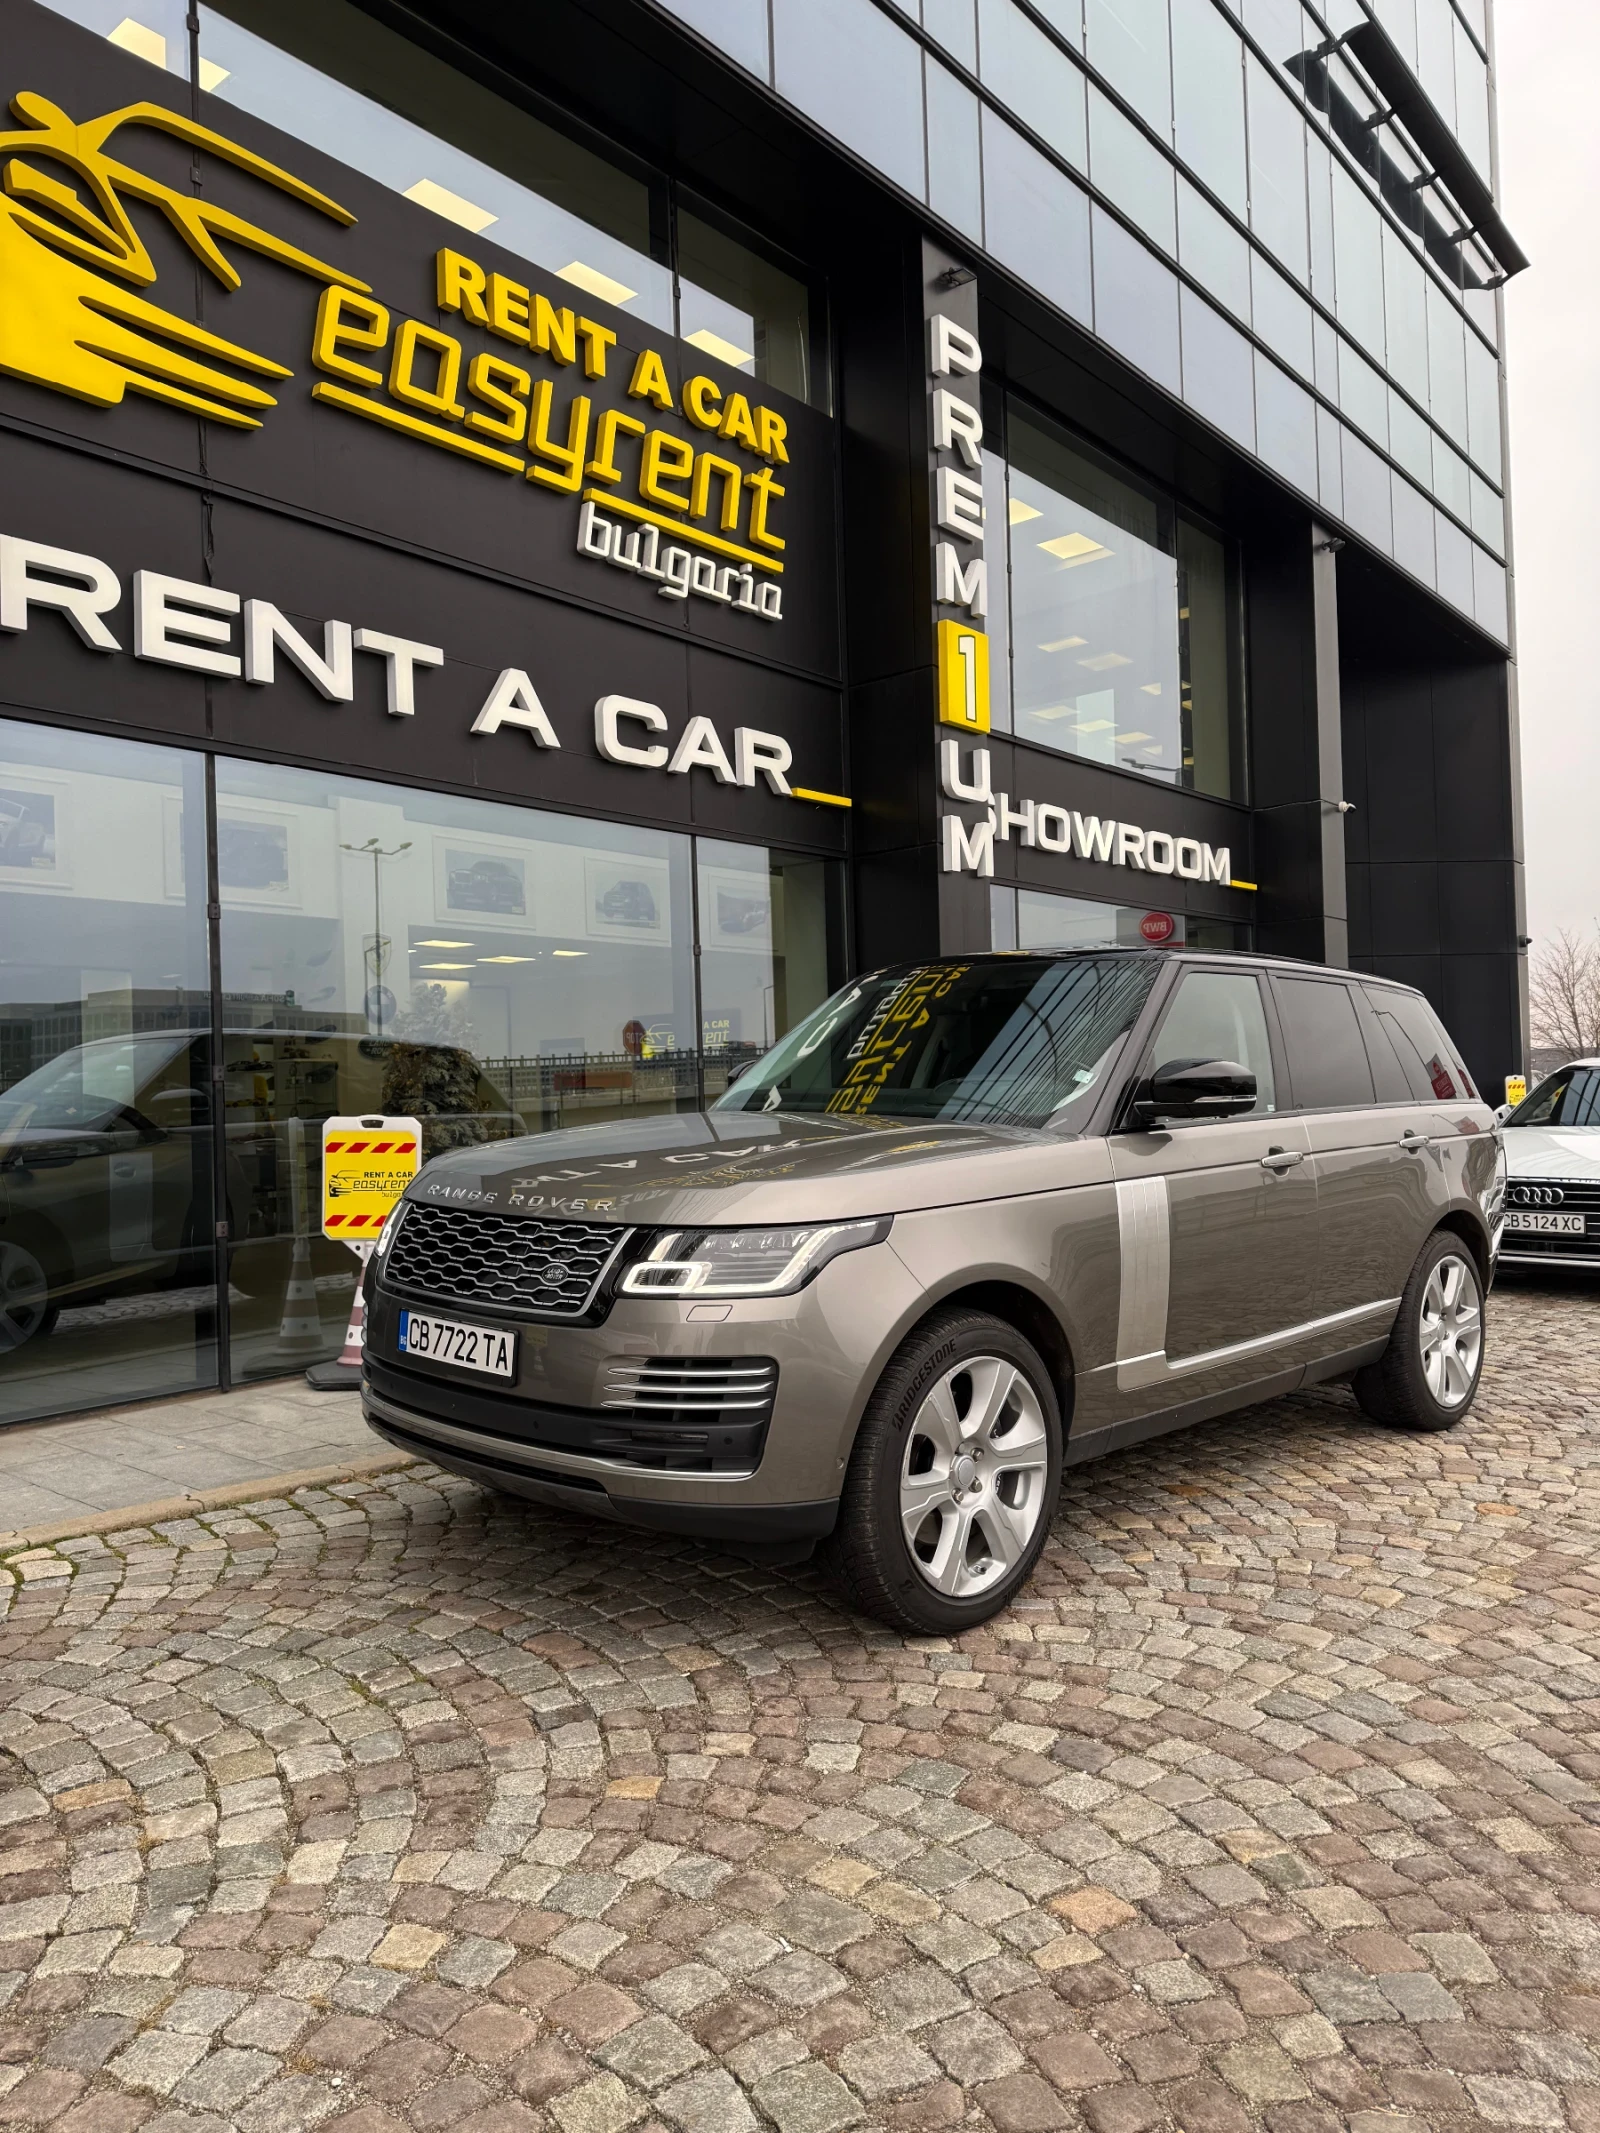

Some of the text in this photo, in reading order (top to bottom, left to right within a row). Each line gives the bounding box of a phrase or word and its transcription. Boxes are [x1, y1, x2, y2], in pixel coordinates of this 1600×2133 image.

[437, 247, 789, 464] RENT A CAR
[312, 285, 785, 551] easyrent
[577, 501, 782, 621] bulgaria
[0, 534, 793, 796] RENT A CAR
[353, 1179, 412, 1191] easyren
[427, 1184, 499, 1204] RANGE
[508, 1193, 613, 1212] ROVER
[1522, 1214, 1559, 1230] 5124
[1562, 1216, 1582, 1231] XC
[409, 1318, 508, 1371] CB 7722 TA
[892, 1338, 957, 1431] BRIDGESTONE
